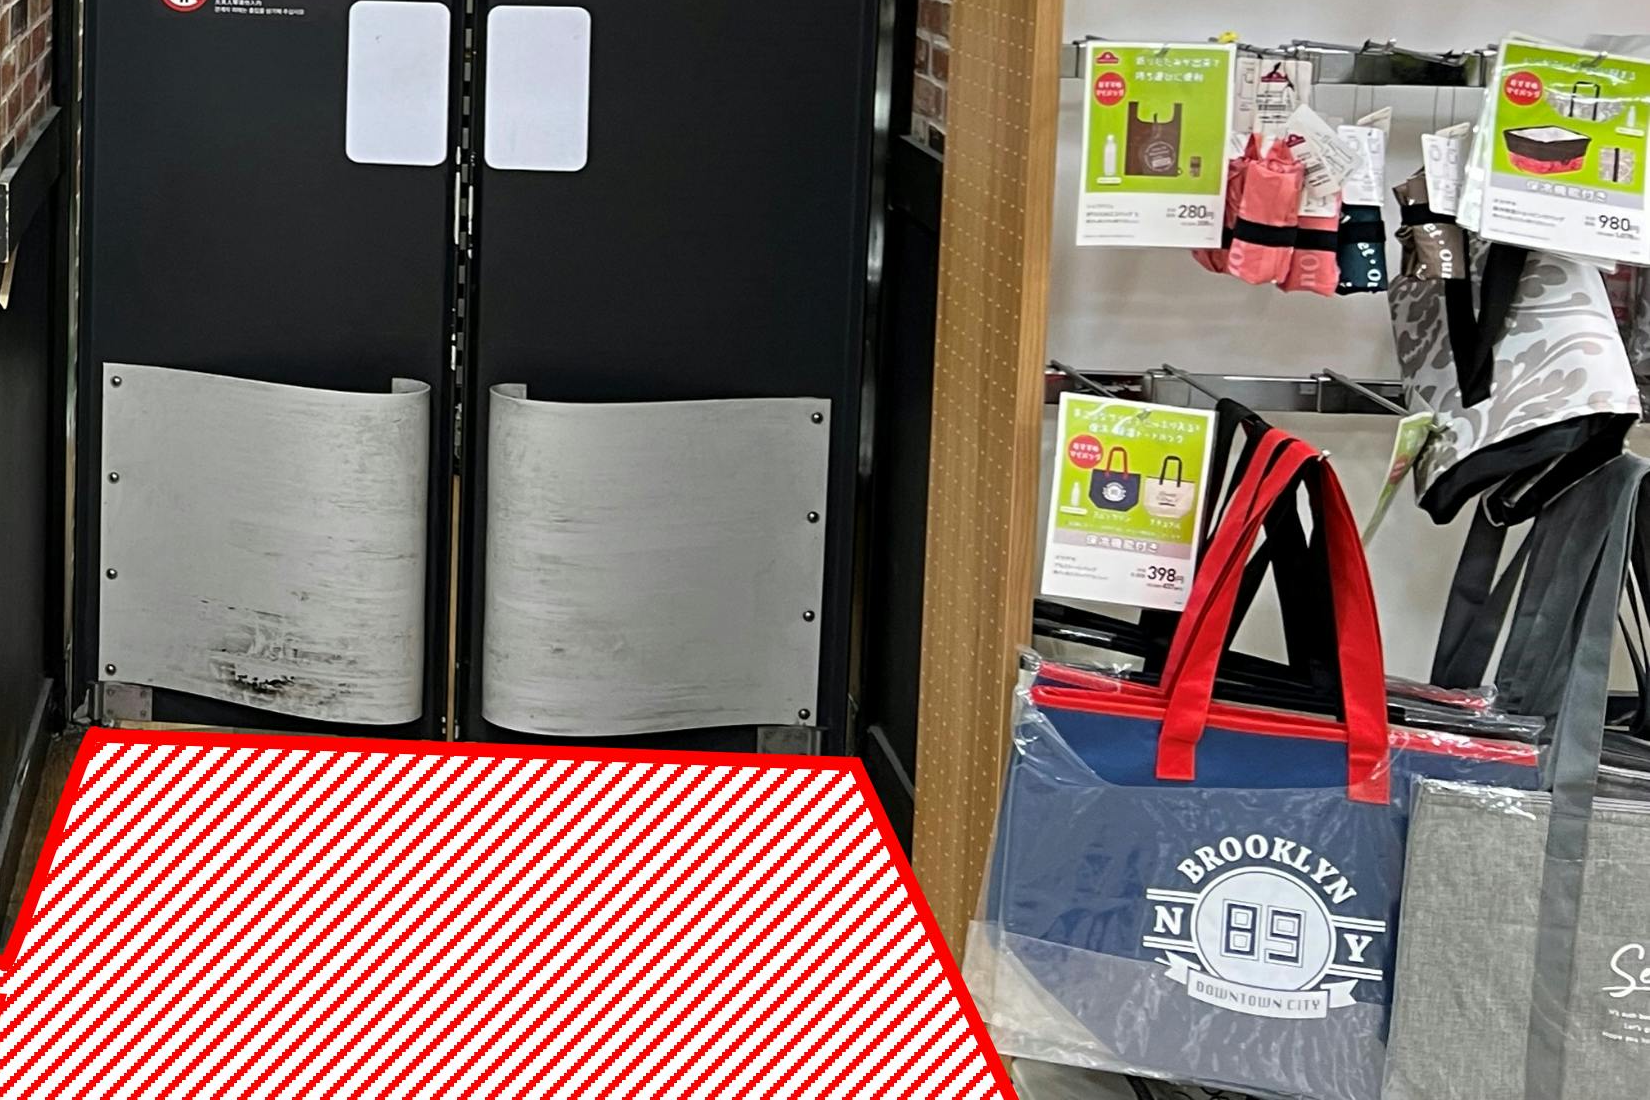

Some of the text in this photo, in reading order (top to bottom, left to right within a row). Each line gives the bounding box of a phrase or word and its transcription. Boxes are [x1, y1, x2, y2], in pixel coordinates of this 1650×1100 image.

[1176, 833, 1358, 906] BROOKLYN
[1153, 899, 1374, 968] N 89 Y
[1195, 980, 1322, 1013] DOWNTOWN CITY
